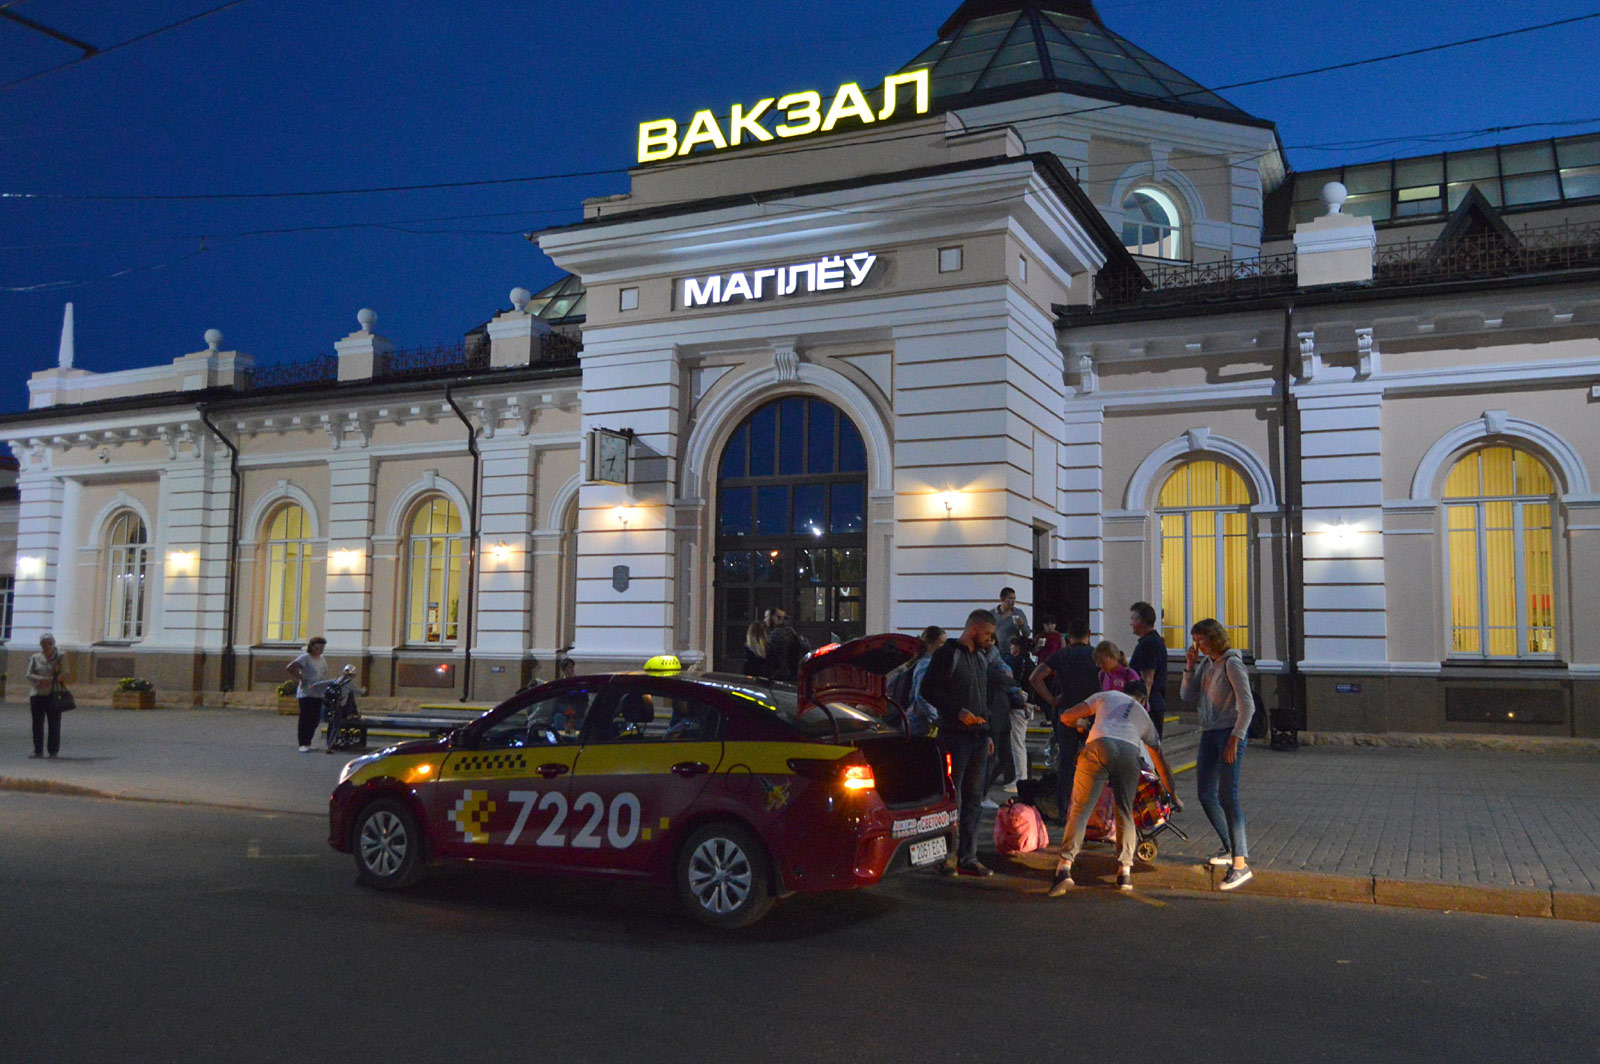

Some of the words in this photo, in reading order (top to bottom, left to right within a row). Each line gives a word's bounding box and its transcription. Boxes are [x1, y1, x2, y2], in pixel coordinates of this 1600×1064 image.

[637, 68, 929, 163] ВАКЗАЛ
[684, 252, 877, 307] МАГІЛЁЎ
[504, 790, 641, 849] 7220
